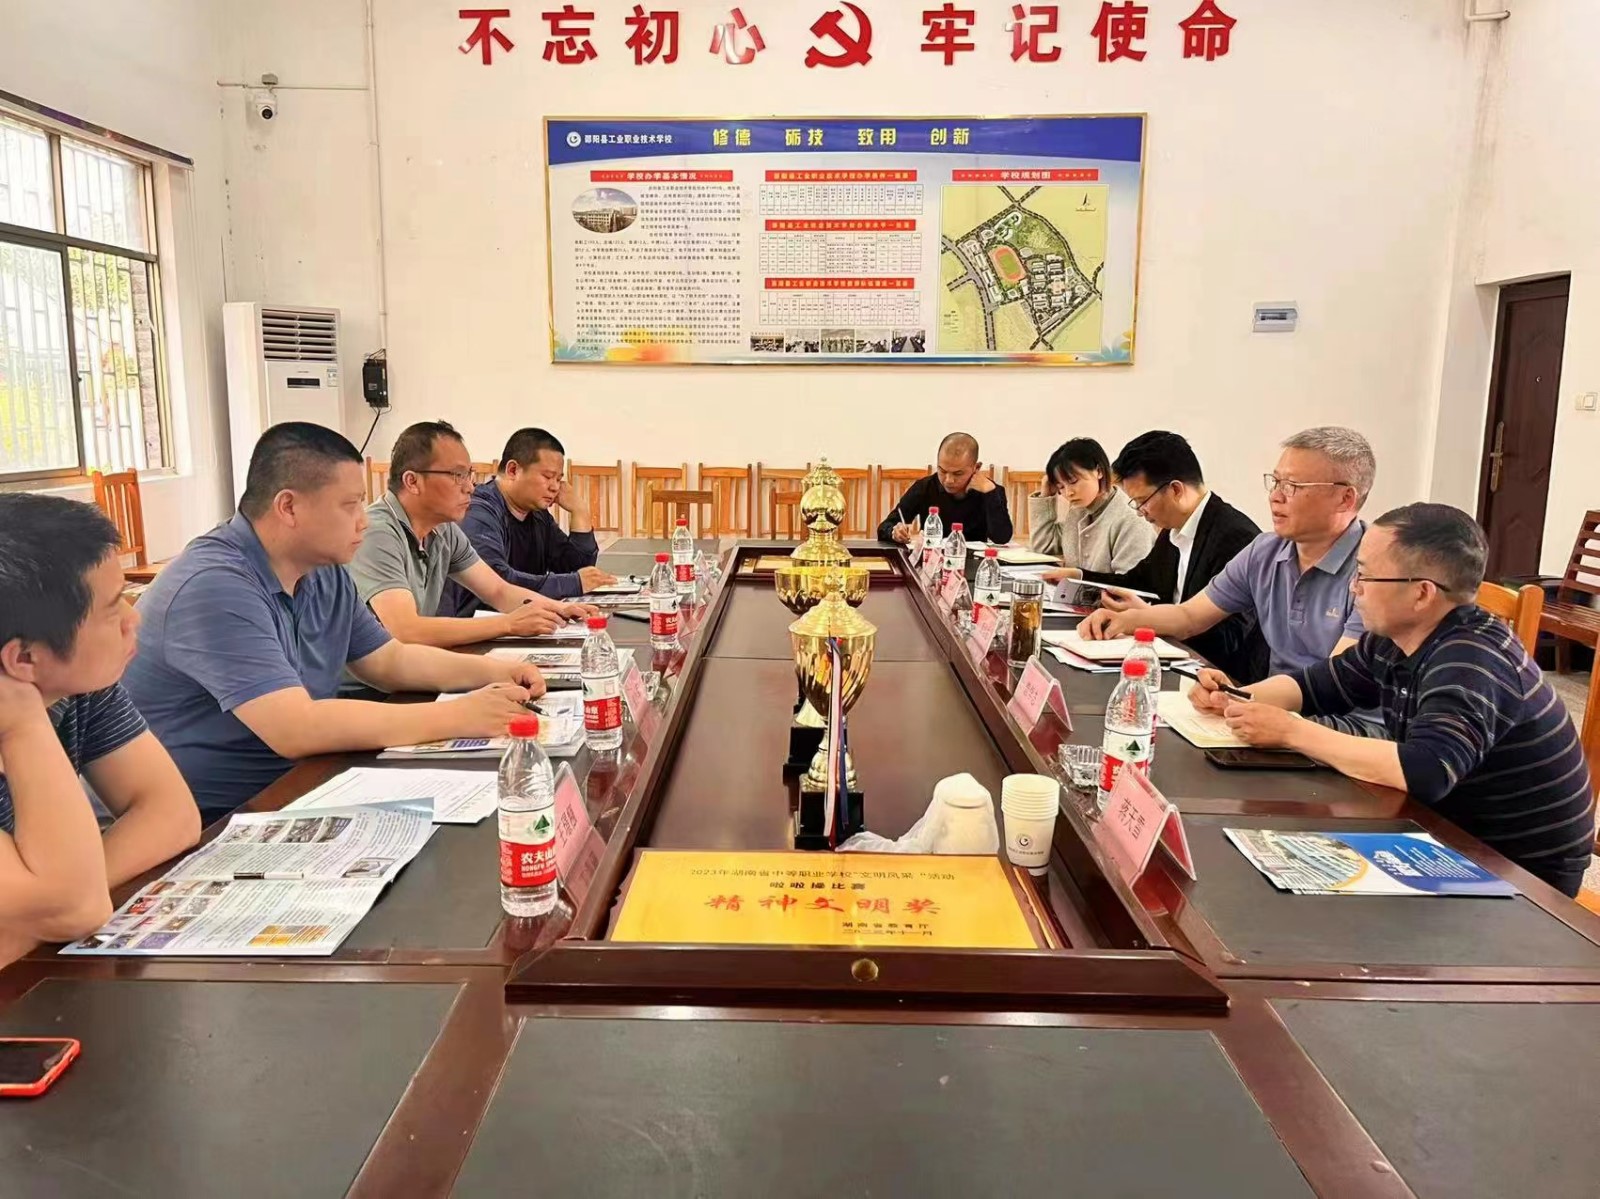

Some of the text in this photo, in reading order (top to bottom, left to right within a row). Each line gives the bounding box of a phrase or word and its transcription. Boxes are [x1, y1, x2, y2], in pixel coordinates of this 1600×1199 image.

[458, 1, 1238, 66] 不忘初心 牢记使命
[584, 134, 673, 144] 邵阳县工业职业技术学校
[712, 127, 970, 146] 修德 砺技 致用 创新
[1000, 171, 1051, 180] 学校规划图
[704, 893, 941, 915] 精神文明奖
